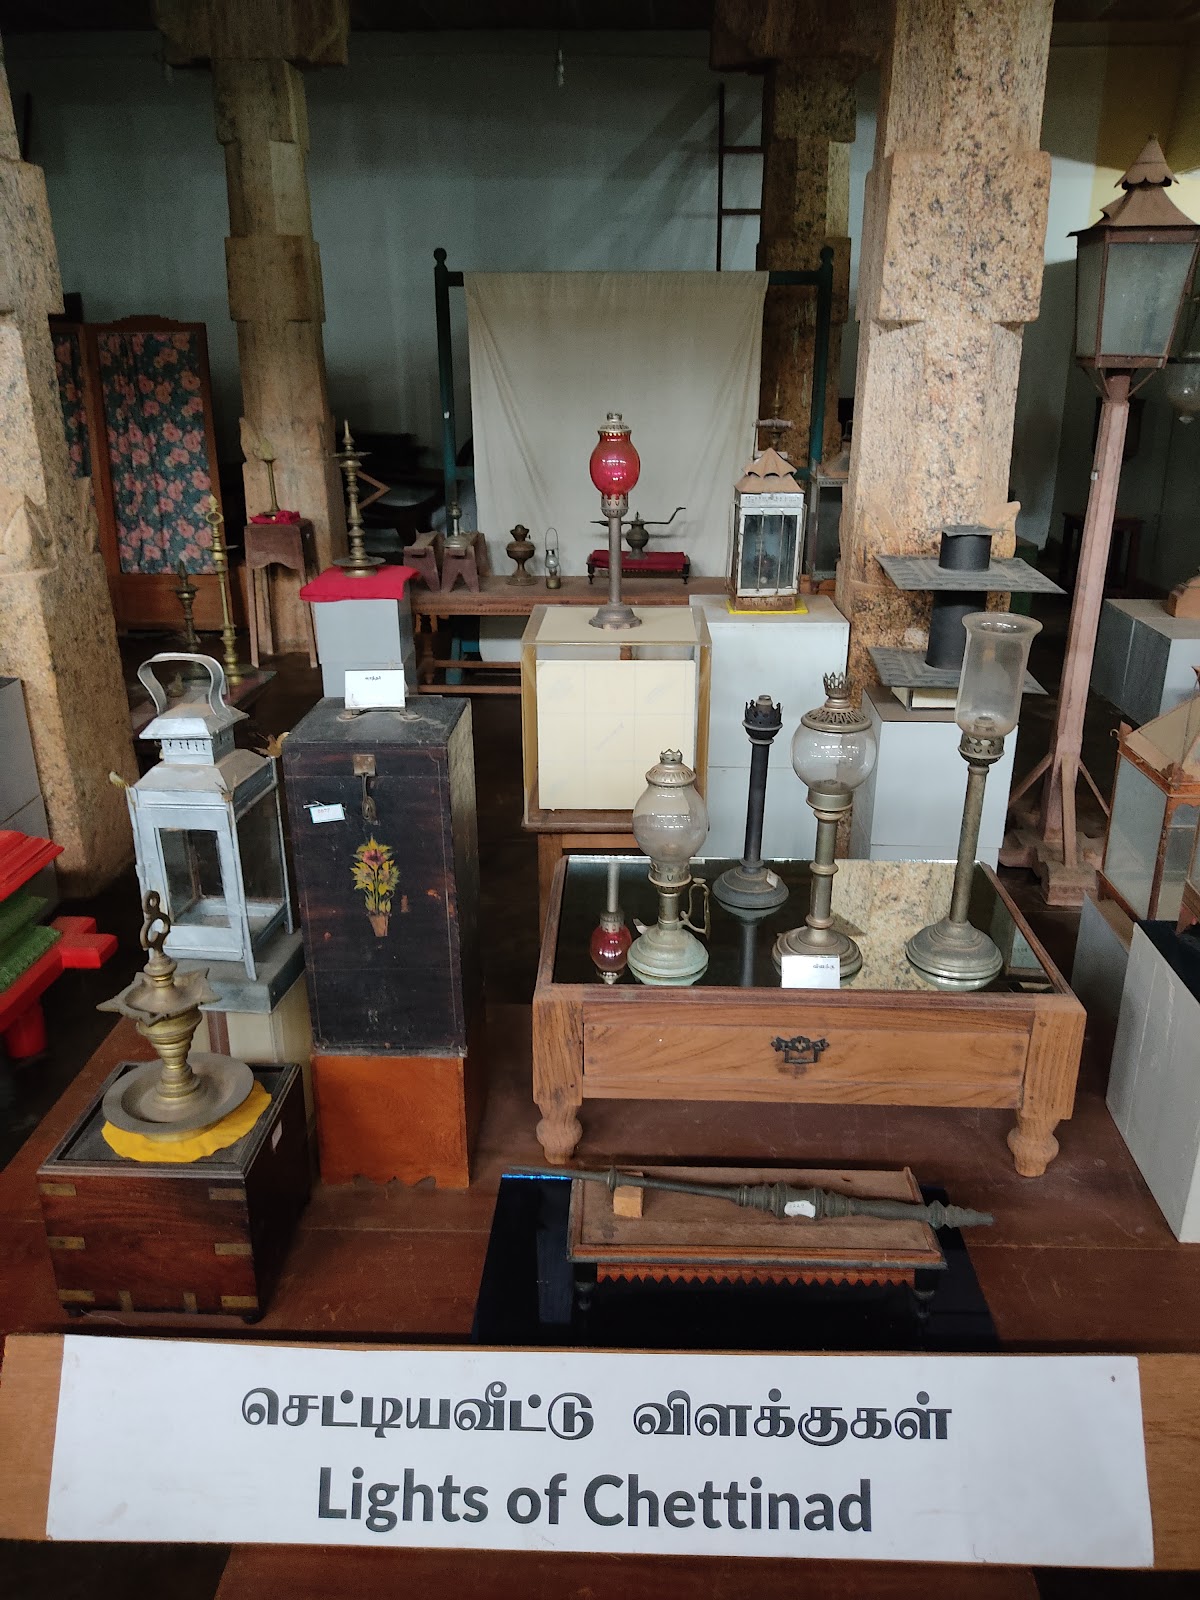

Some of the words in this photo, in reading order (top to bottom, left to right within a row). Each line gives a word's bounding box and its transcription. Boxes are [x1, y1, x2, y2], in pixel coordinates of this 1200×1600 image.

[241, 1381, 594, 1441] செட்டியவீட்டு
[633, 1388, 953, 1447] விளக்குகள்
[318, 1466, 489, 1533] Lights
[506, 1472, 568, 1525] of
[583, 1473, 872, 1533] Chettinad
